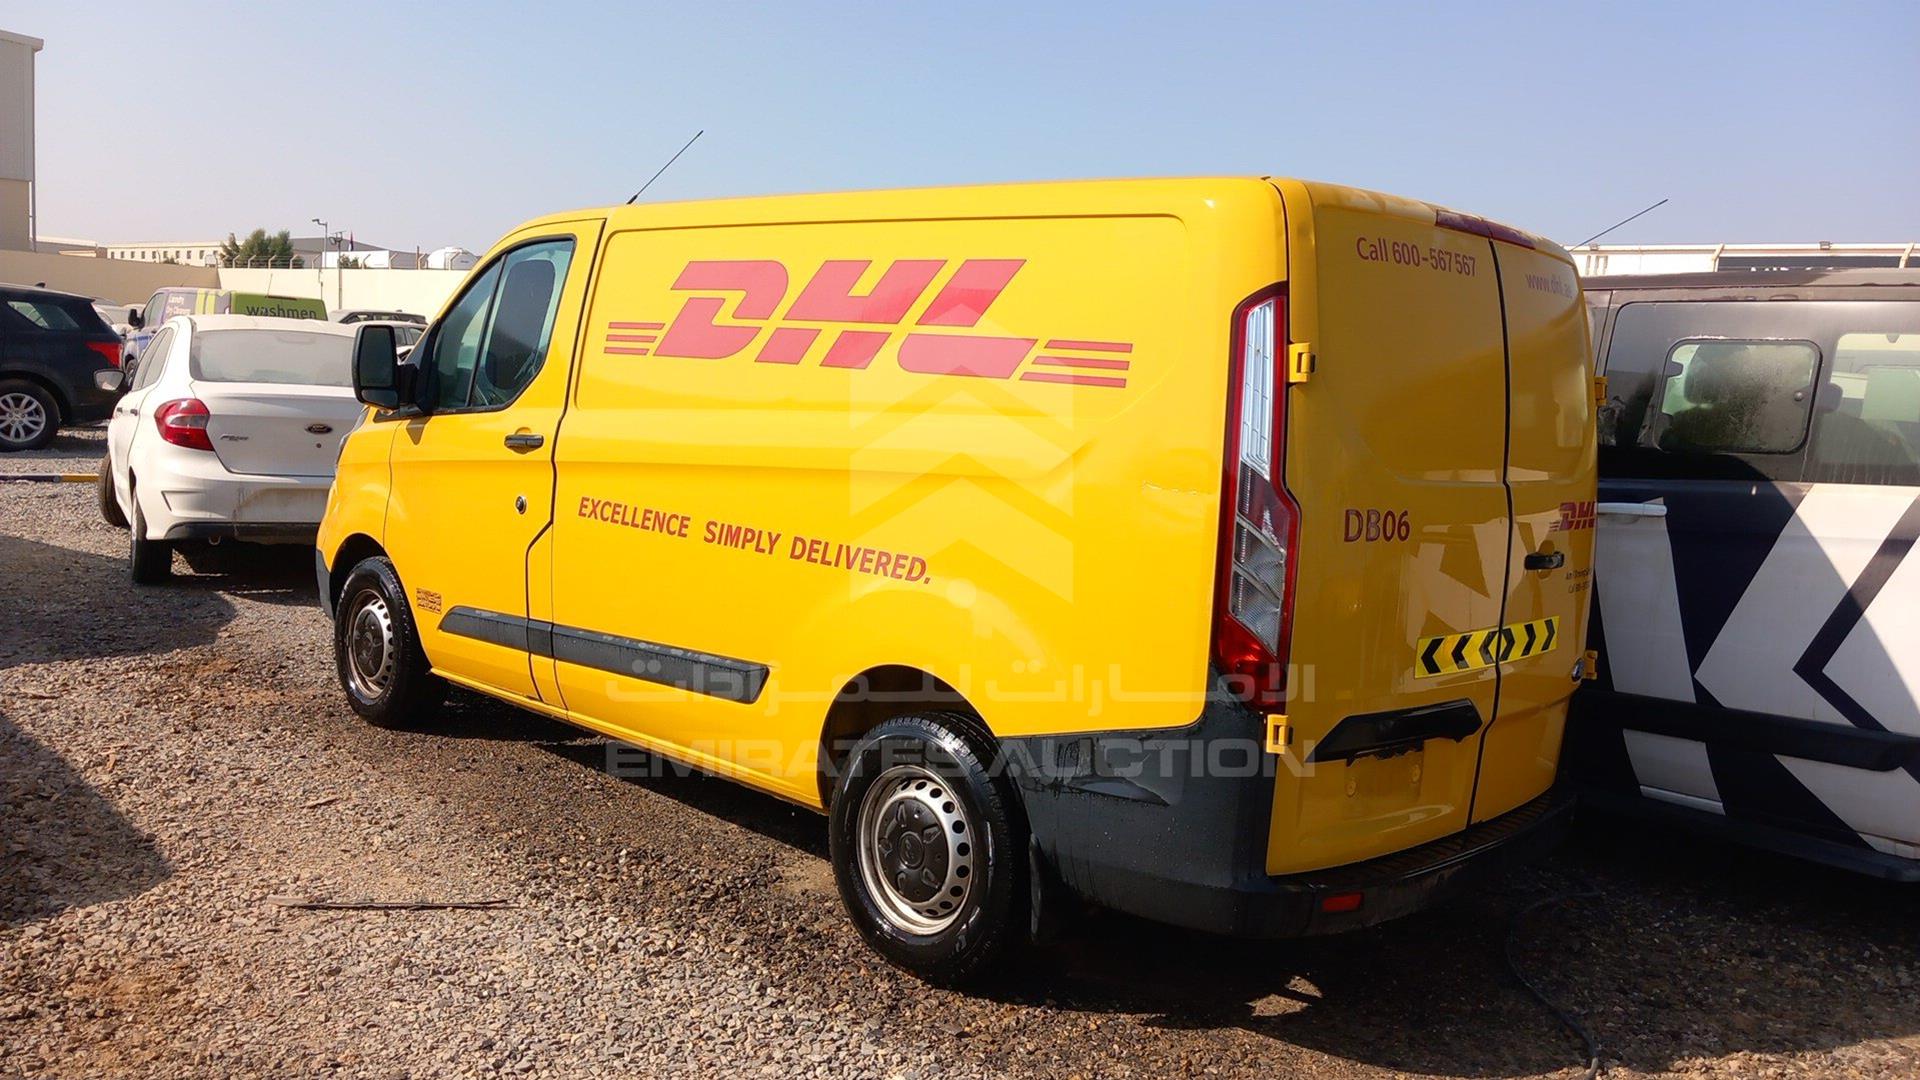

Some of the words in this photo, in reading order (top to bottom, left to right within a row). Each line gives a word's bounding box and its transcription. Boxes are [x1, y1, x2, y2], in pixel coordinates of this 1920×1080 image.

[1356, 237, 1388, 262] Call
[246, 304, 317, 319] washmen
[653, 259, 1038, 379] DHL
[578, 496, 691, 538] EXCELLENCE
[703, 520, 782, 555] SIMPLY
[789, 536, 931, 585] DELIVERED.
[1343, 508, 1410, 542] DB06
